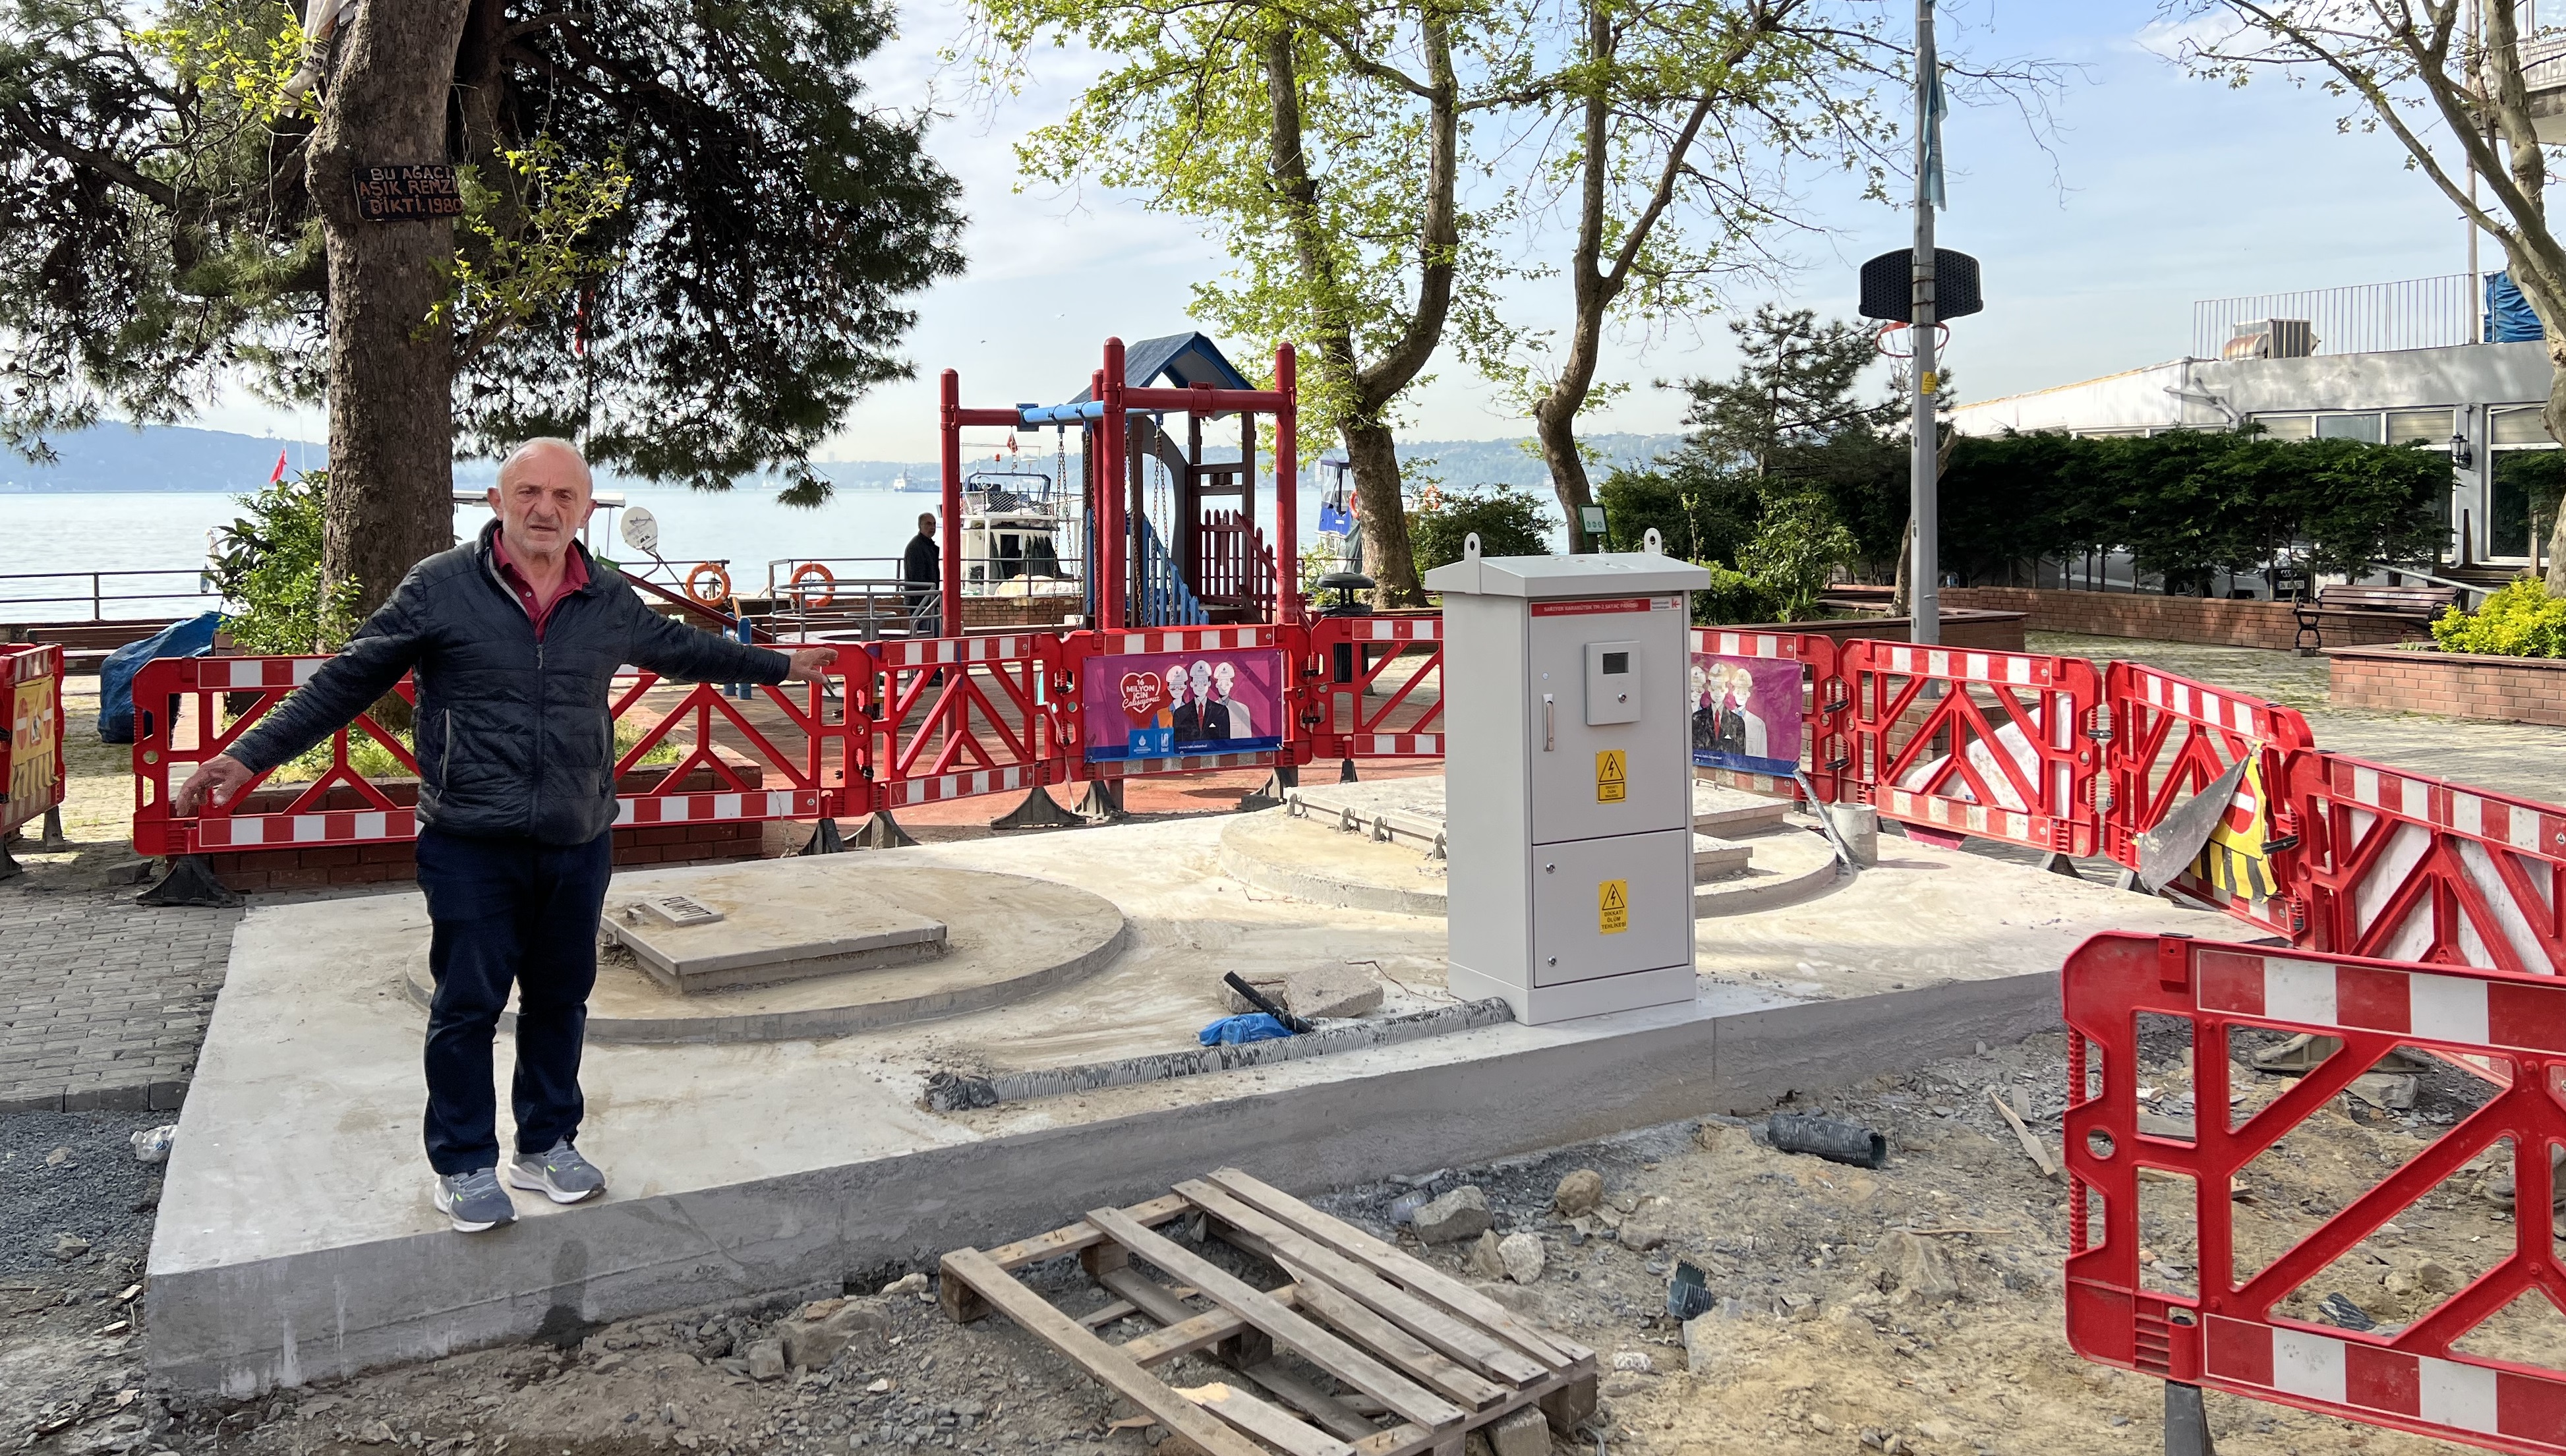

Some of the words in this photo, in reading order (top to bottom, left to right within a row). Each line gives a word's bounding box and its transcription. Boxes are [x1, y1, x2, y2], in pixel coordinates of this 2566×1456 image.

[370, 167, 395, 181] BU
[403, 165, 451, 180] AĞACI
[407, 175, 459, 194] REMZİ
[428, 198, 463, 214] 1980
